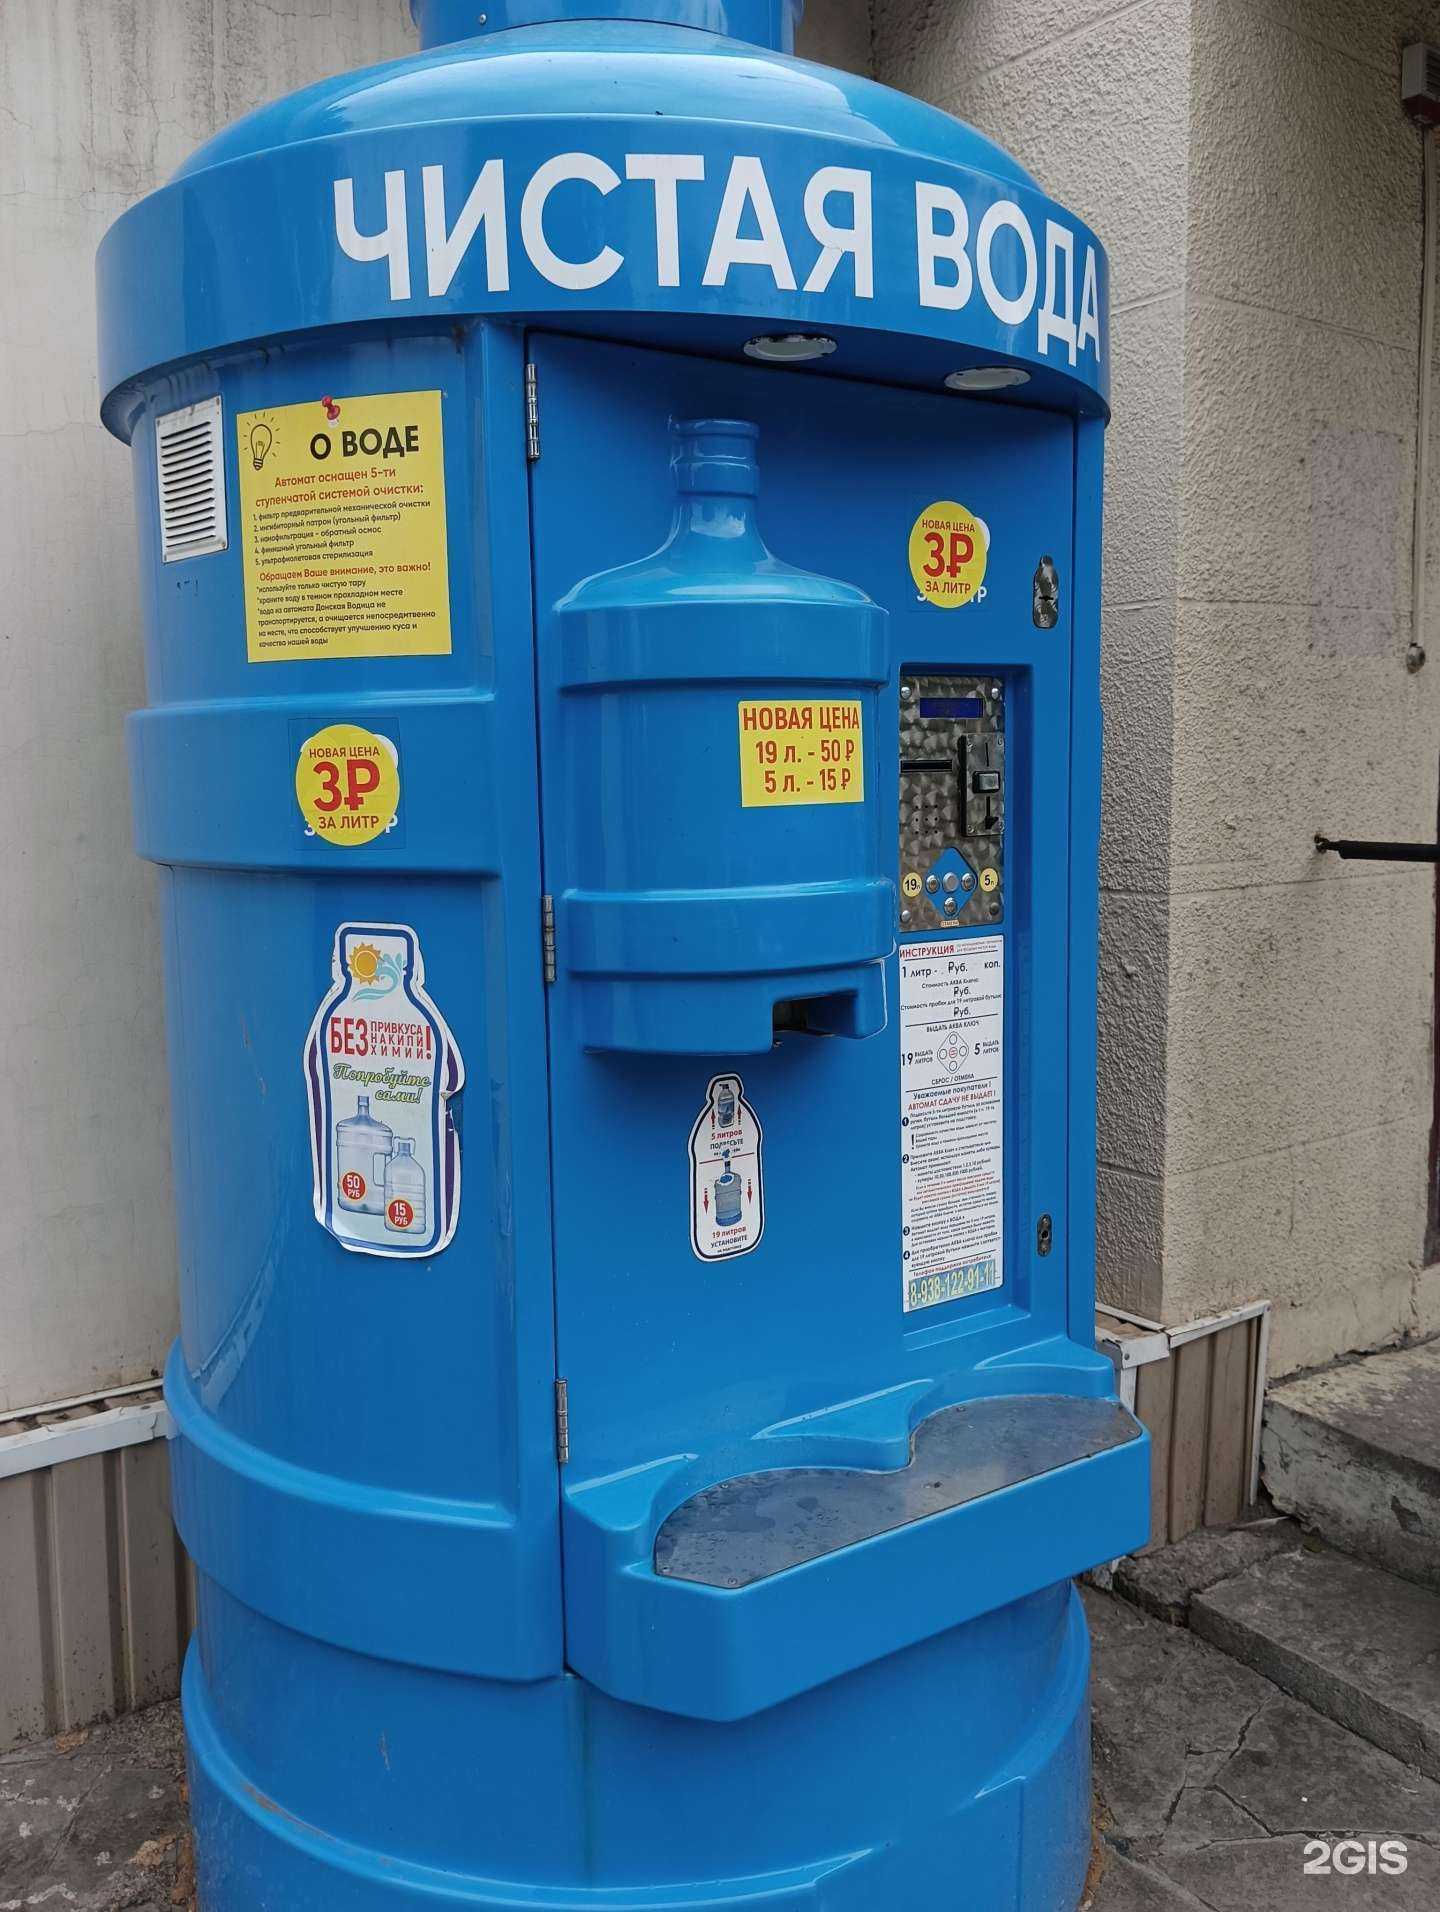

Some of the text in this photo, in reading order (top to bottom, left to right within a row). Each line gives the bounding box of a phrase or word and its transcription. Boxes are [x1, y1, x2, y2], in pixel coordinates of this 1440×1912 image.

[334, 152, 1100, 366] ЧИСТАЯ ВОДА
[310, 425, 419, 460] О ВОДЕ
[275, 467, 396, 488] Автомат оснащен 5-ти
[256, 484, 423, 508] ступенчатой системой очистки:
[281, 504, 341, 517] предварительной
[343, 501, 397, 512] механической
[399, 501, 431, 509] очистки
[306, 519, 331, 527] патрон
[333, 515, 369, 526] (угольный
[371, 512, 400, 523] фильтр)
[922, 519, 975, 533] НОВАЯ ЦЕНА
[321, 526, 356, 538] обратный
[295, 540, 327, 551] угольный
[329, 540, 354, 549] фильтр
[322, 550, 373, 560] стерилизация
[260, 562, 431, 582] Обращаем Ваше внимание, это важно!
[298, 582, 319, 590] только
[321, 581, 347, 589] чистую
[349, 580, 366, 588] тару
[925, 581, 939, 593] ЗА
[942, 581, 971, 595] ЛИТР
[381, 589, 404, 597] месте
[316, 603, 345, 612] Донская
[347, 601, 375, 610] Водица
[325, 614, 364, 623] очищается
[743, 706, 860, 732] НОВАЯ ЦЕНА
[309, 745, 380, 759] НОВАЯ ЦЕНА
[755, 740, 777, 764] 19
[821, 739, 841, 762] 50
[764, 770, 777, 793] 5
[819, 768, 837, 791] 15
[318, 816, 336, 829] ЗА
[340, 815, 380, 829] ЛИТР
[900, 945, 954, 959] ИНСТРУКЦИЯ
[902, 966, 907, 978] 1
[910, 968, 931, 978] литр
[984, 960, 1001, 969] коп.
[330, 1016, 423, 1057] БЕЗ ПРИВКУСА
[370, 1032, 424, 1047] НАКИПИ
[370, 1044, 424, 1060] ХИМИИ
[974, 1043, 980, 1055] 5
[902, 1053, 913, 1066] 19
[333, 1062, 432, 1089] Попробуйте
[931, 1076, 949, 1085] СБРОС
[375, 1087, 424, 1104] сами!
[913, 1089, 952, 1100] Уважаемые
[908, 1099, 938, 1111] АВТОМАТ
[938, 1096, 960, 1106] СДАЧУ
[962, 1094, 969, 1102] НЕ
[711, 1129, 743, 1140] 5 литров
[346, 1174, 360, 1189] 50
[347, 1188, 360, 1198] РУБ
[394, 1202, 406, 1216] 15
[722, 1226, 746, 1236] литров
[711, 1234, 748, 1248] УСТАНОВИТЕ
